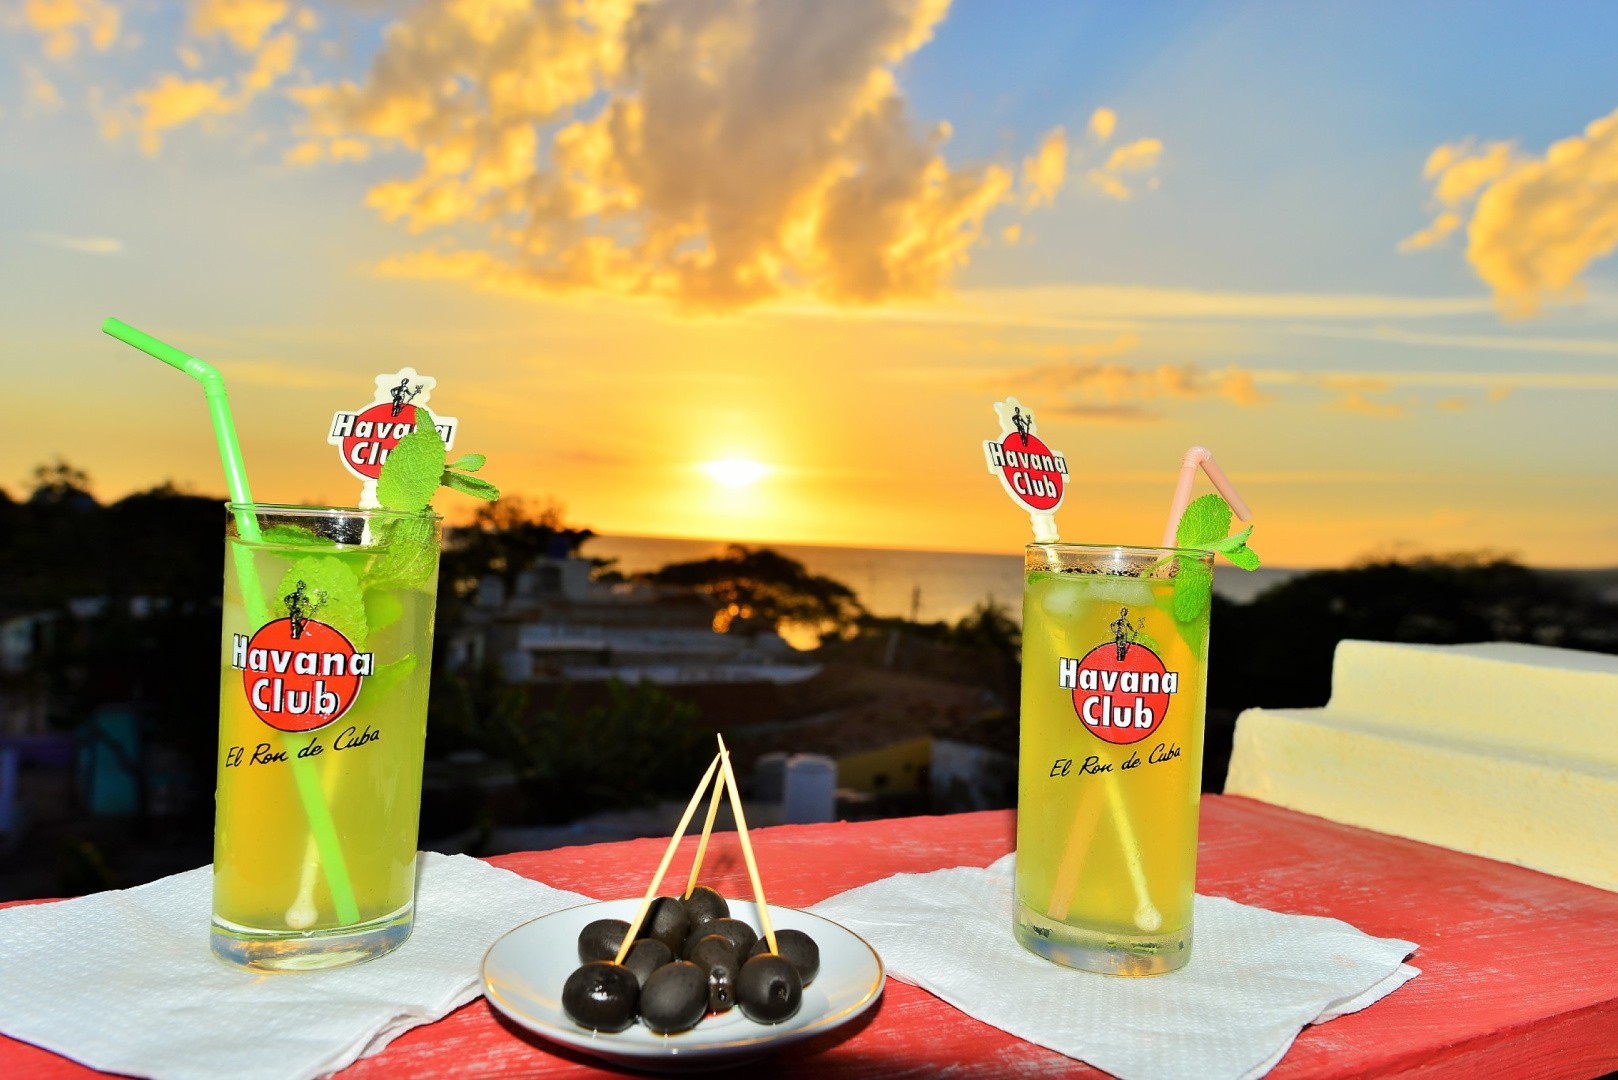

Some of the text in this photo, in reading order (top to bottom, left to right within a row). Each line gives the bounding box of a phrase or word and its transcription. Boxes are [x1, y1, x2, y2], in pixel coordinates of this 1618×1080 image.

[332, 414, 452, 442] Havaa
[989, 442, 1068, 474] Havana
[1013, 471, 1058, 498] Club
[232, 633, 374, 676] Havana
[1059, 657, 1178, 694] Havana
[252, 677, 340, 715] Club
[1082, 695, 1154, 729] Club
[226, 725, 380, 767] El Ron de Cuba
[1050, 743, 1181, 777] El Ron de Cuba
